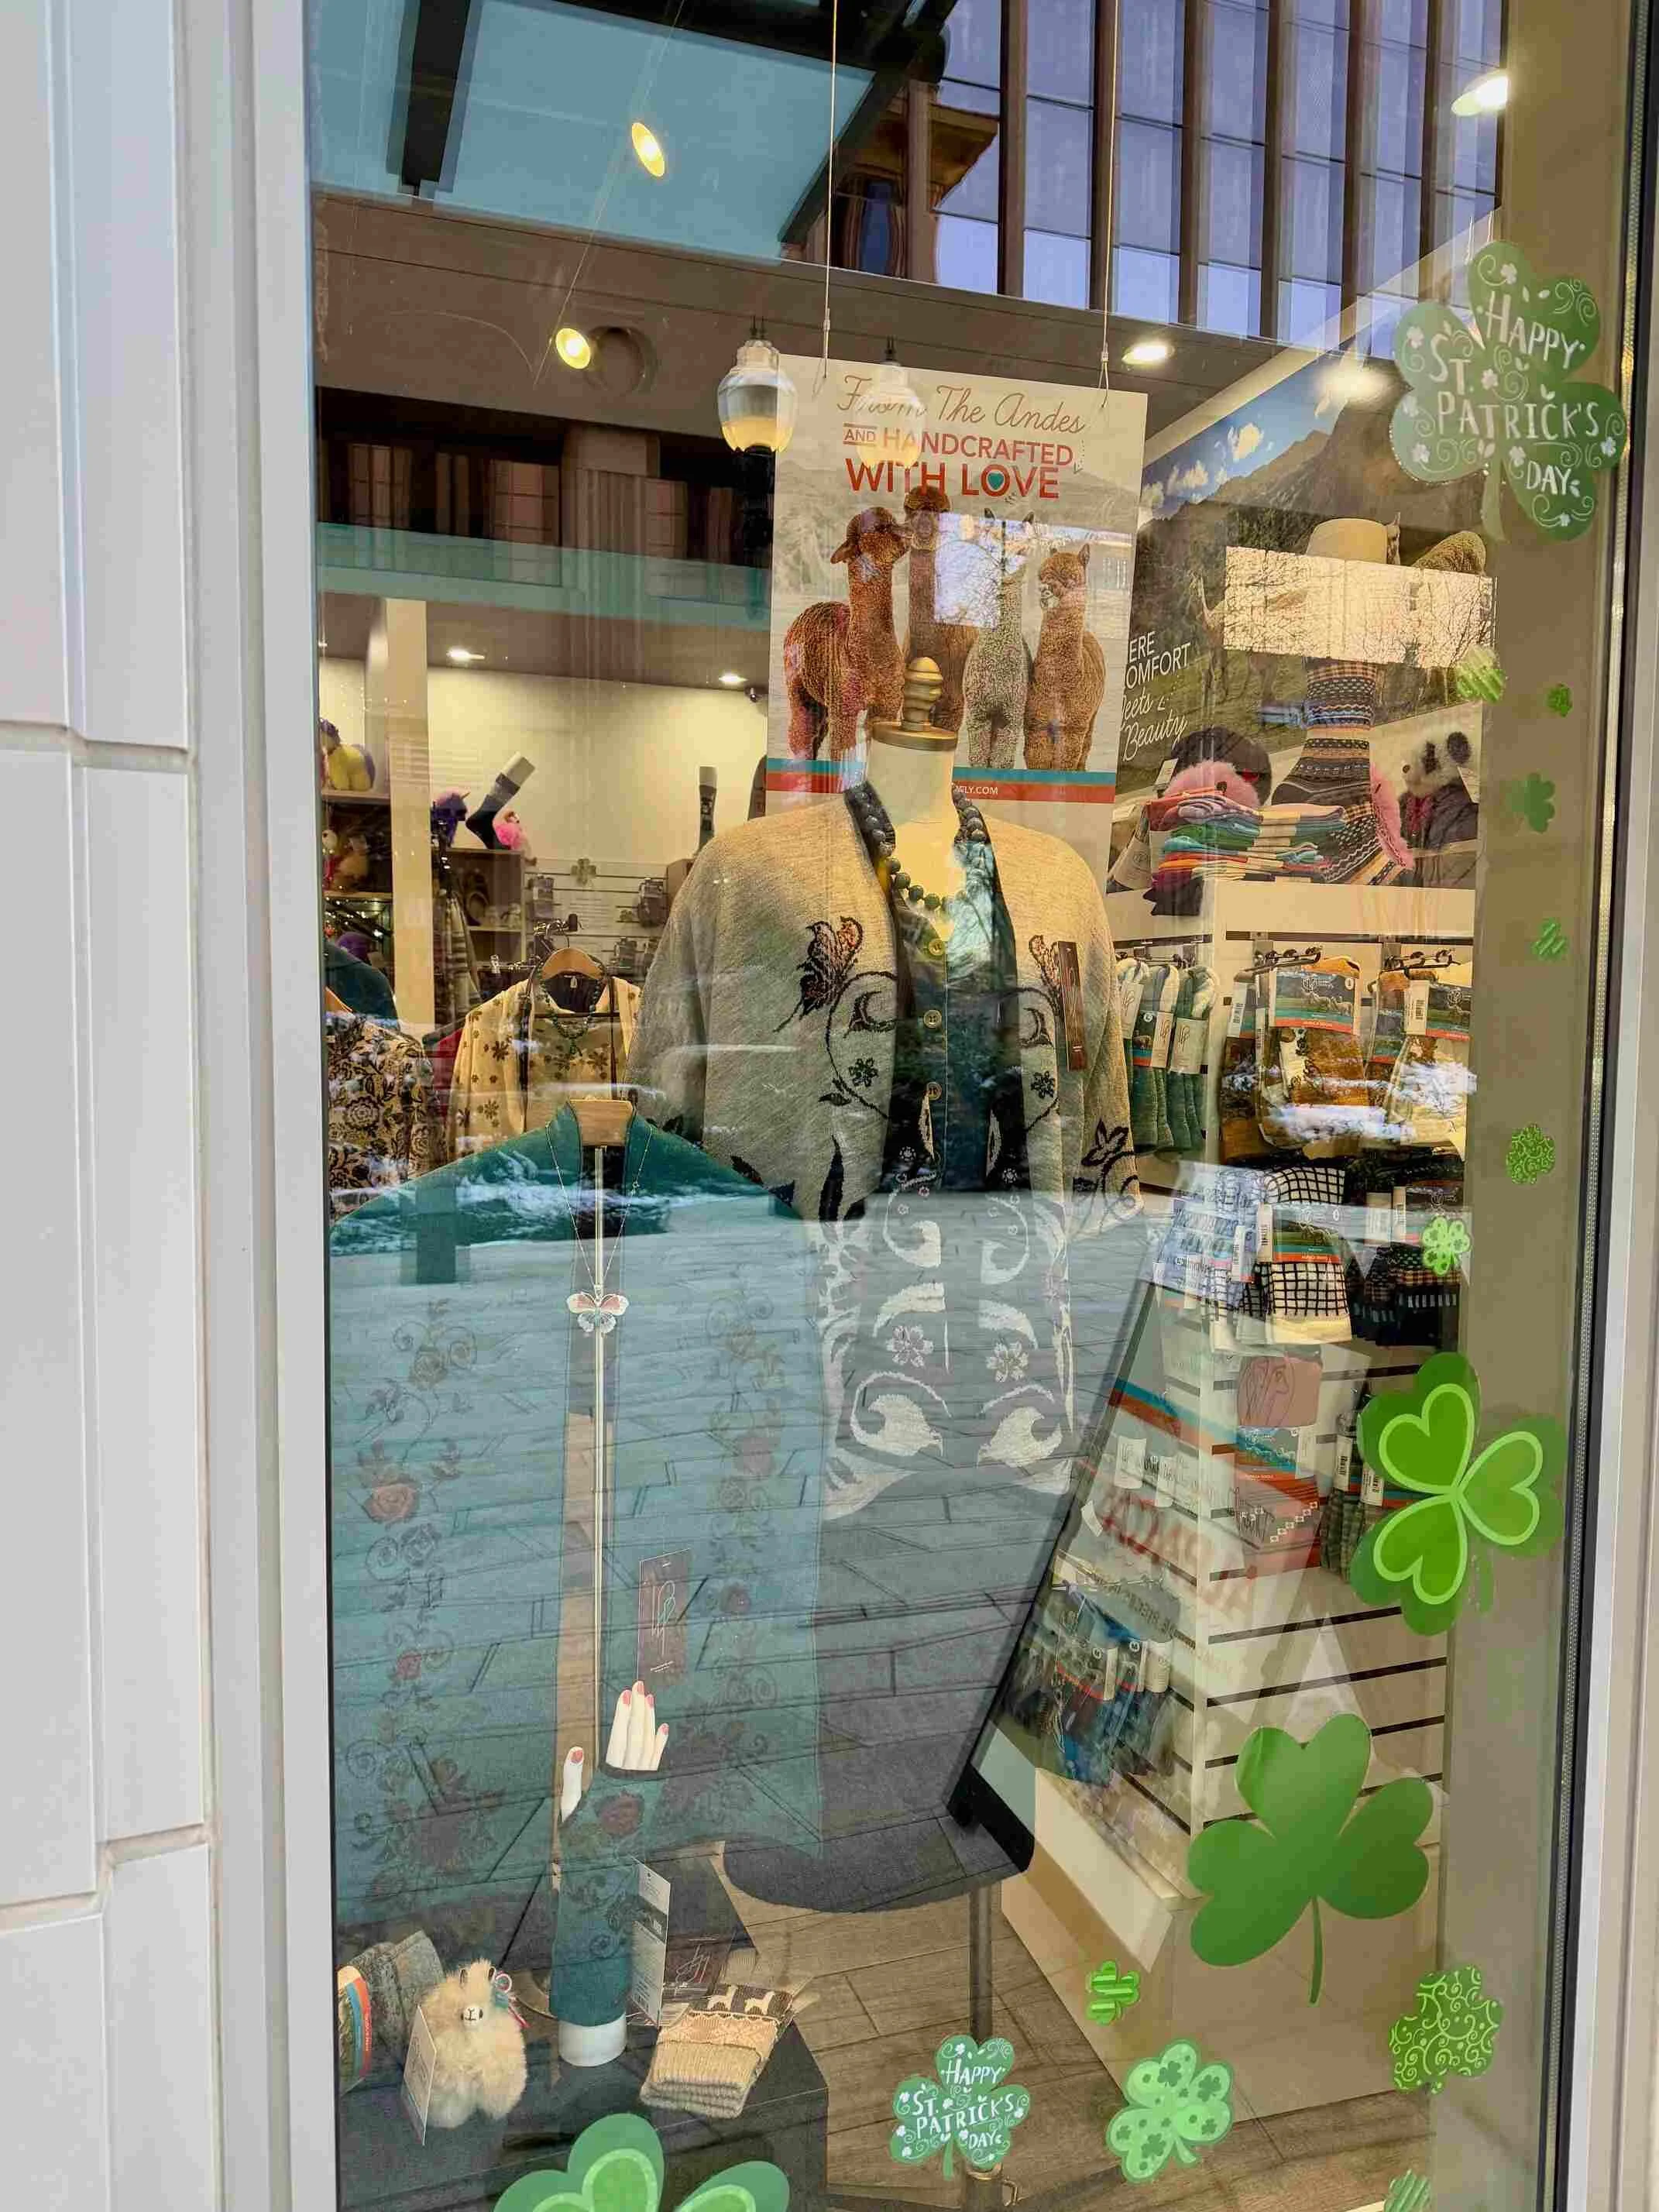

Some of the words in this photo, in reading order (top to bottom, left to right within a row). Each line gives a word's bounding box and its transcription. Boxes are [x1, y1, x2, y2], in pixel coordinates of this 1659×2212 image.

[1485, 290, 1578, 369] HAPPY
[1429, 333, 1474, 395] ST.
[936, 385, 986, 424] The
[994, 393, 1086, 434] Andes
[1437, 391, 1600, 440] PATRICK'S
[844, 428, 877, 444] AND
[884, 428, 1073, 466] HANDCRAFTED
[845, 458, 946, 495] WITH
[962, 464, 1060, 499] LOVE
[1526, 461, 1571, 495] DAY
[1125, 642, 1192, 689] OMFORT
[1129, 631, 1156, 663] ERE
[1121, 709, 1188, 762] Beauty
[946, 2059, 1001, 2084] HAPPY
[912, 2090, 939, 2117] ST.
[917, 2094, 1015, 2138] PATRICK'S
[969, 2130, 998, 2150] DAY
